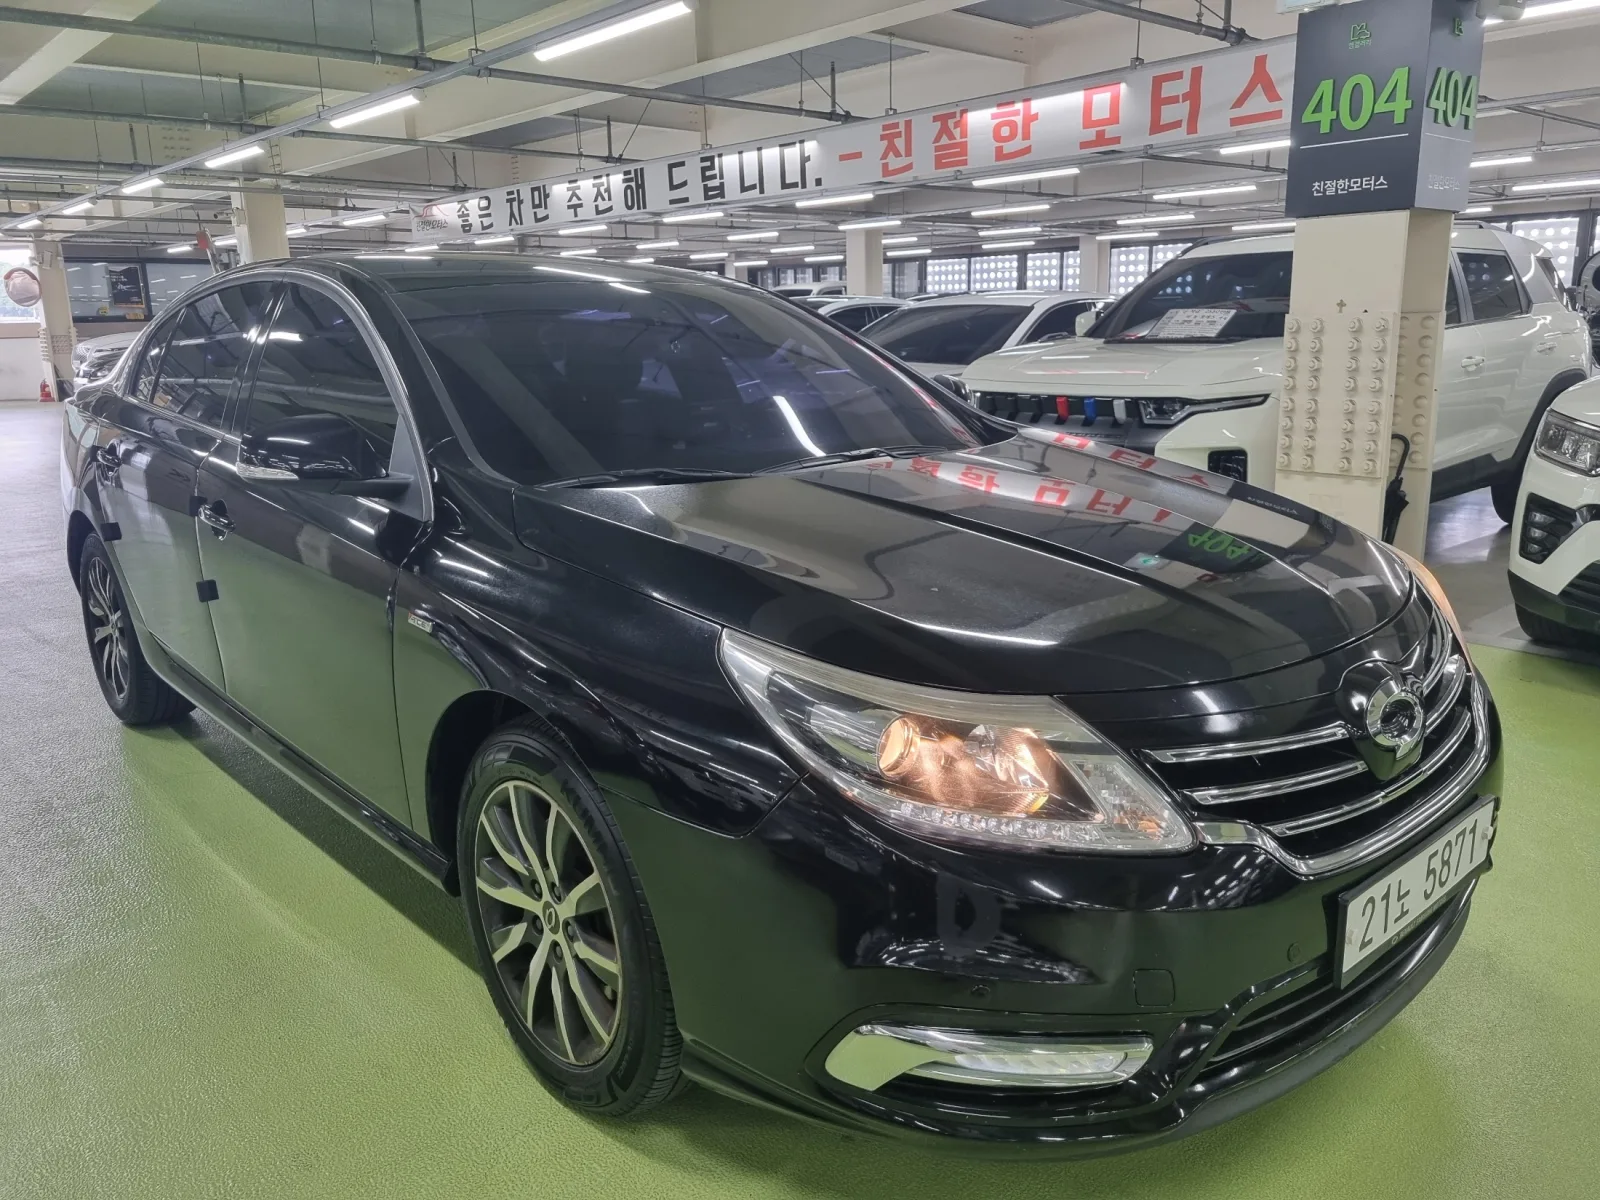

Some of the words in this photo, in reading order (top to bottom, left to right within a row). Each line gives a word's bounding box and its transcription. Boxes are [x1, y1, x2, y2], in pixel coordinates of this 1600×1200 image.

[1301, 66, 1412, 134] 404
[1427, 66, 1478, 131] 404
[456, 195, 494, 234] 좋은
[505, 183, 551, 227] 차만
[566, 167, 648, 218] 추천해
[668, 139, 823, 206] 드립니다.
[879, 97, 1039, 178] 친절한
[1079, 53, 1284, 150] 모터스
[1311, 175, 1389, 197] 친절한모터스
[1358, 878, 1411, 953] 21노
[1423, 818, 1478, 901] 5871
